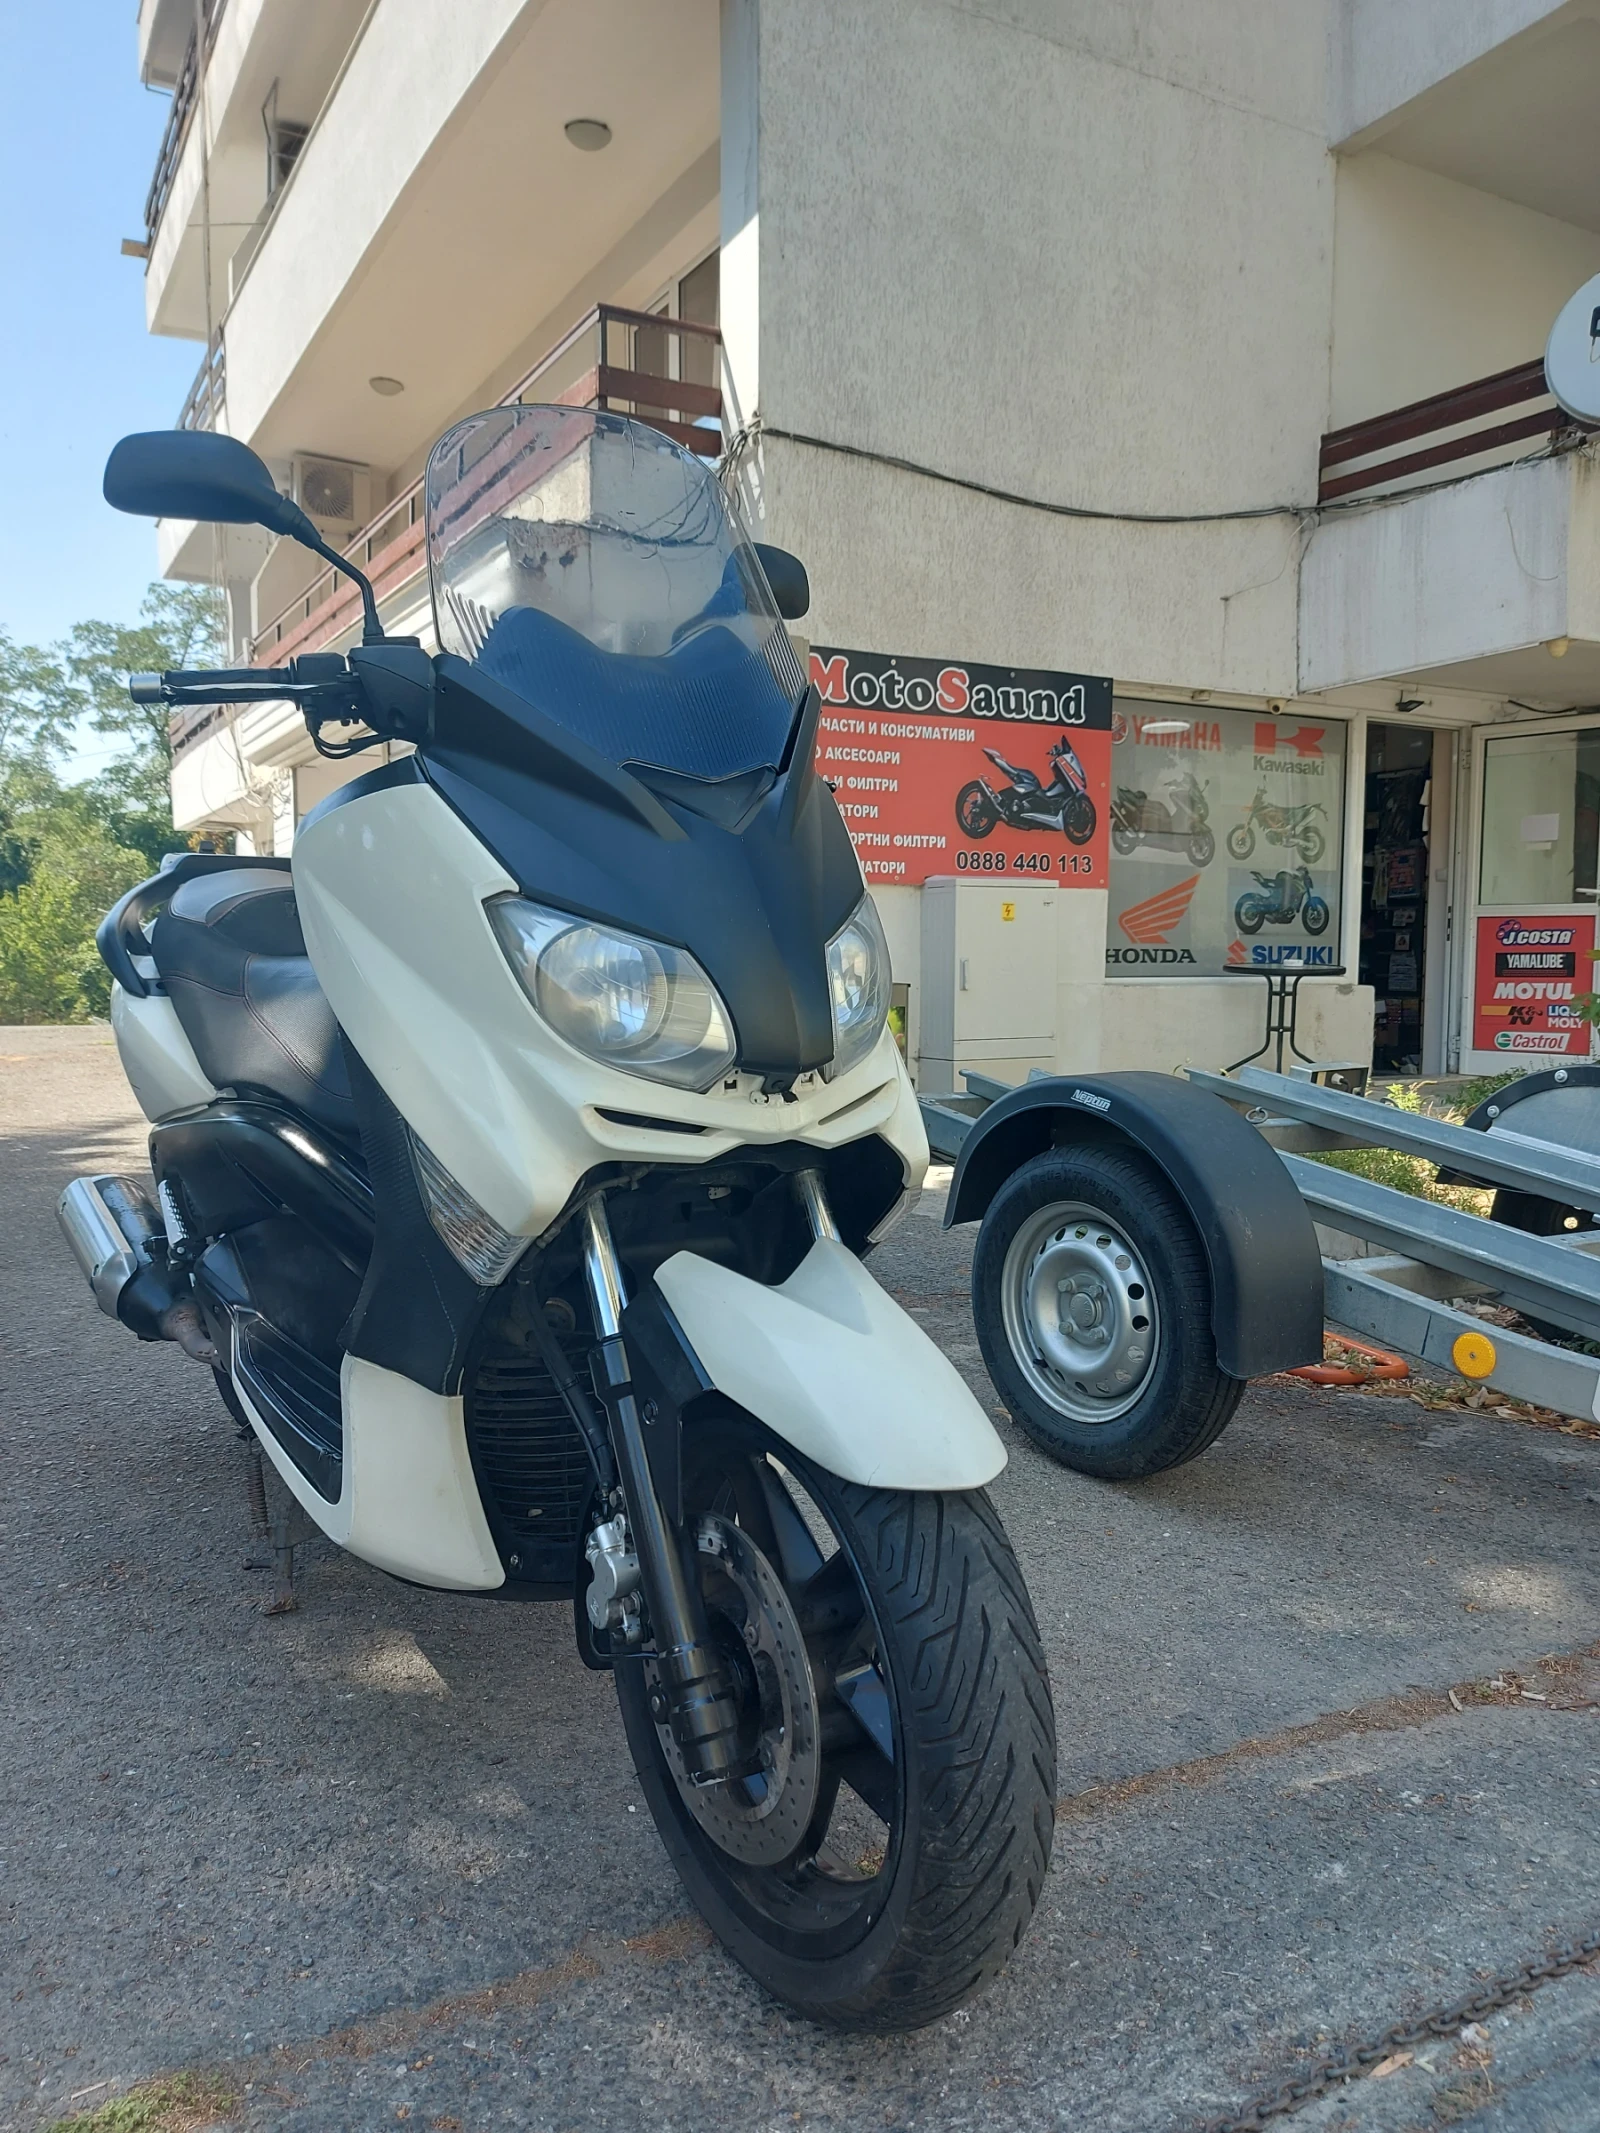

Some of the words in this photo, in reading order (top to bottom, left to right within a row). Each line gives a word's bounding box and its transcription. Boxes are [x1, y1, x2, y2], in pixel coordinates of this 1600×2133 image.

[809, 653, 1086, 724] MotoSaund
[819, 717, 865, 734] ЧАСТИ
[868, 721, 877, 735] И
[880, 723, 975, 742] КОНСУМАТИВИ
[1132, 715, 1222, 752] YAMAHA
[825, 746, 900, 764] АКСЕСОАРИ
[1253, 755, 1325, 776] Kawasaki
[847, 776, 898, 792] ФИЛТРИ
[838, 804, 879, 818] АТОРИ
[850, 832, 890, 846] ОРТНИ
[893, 835, 946, 848] ФИЛТРИ
[861, 860, 905, 874] АТОРИ
[956, 850, 1006, 871] 0888
[1012, 852, 1051, 873] 440
[1058, 854, 1093, 874] 113
[1502, 930, 1573, 945] J.COSTA
[1105, 948, 1197, 964] HONDA
[1252, 945, 1333, 965] SUZUKI
[1507, 954, 1565, 968] YAMALUBE
[1493, 982, 1575, 1000] MOTUL
[1547, 1017, 1584, 1028] MOLY
[1512, 1034, 1565, 1049] Castrol
[1071, 1089, 1111, 1111] Neptun
